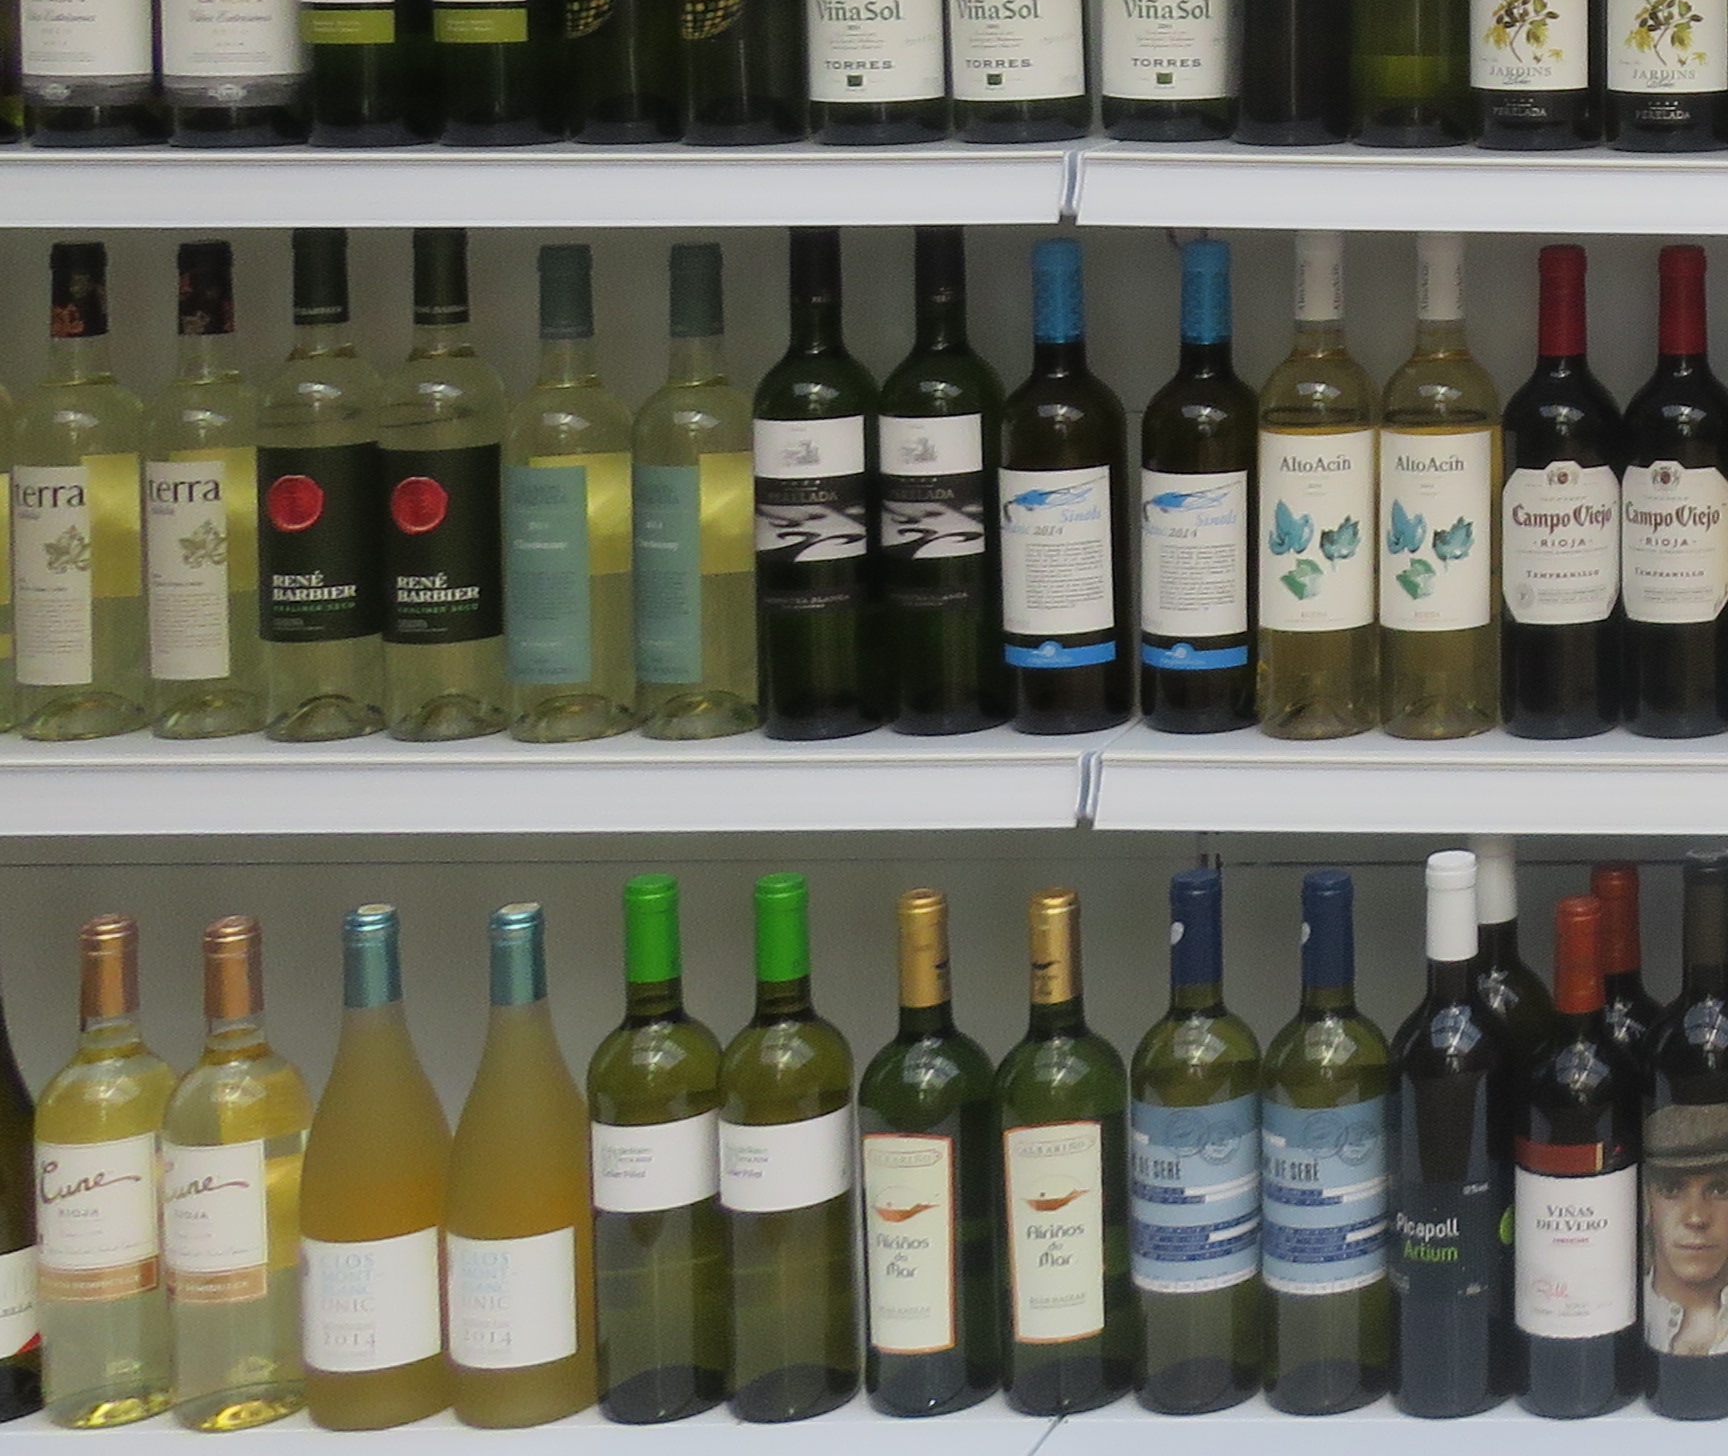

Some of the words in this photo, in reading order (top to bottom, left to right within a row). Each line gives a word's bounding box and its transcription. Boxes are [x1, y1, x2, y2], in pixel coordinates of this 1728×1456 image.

[1632, 68, 1697, 82] JARDINS
[1512, 504, 1571, 535] Campo
[1573, 503, 1613, 528] Viejo
[1625, 505, 1673, 535] Campo
[1675, 503, 1720, 529] Viejo
[1033, 524, 1064, 537] 2014
[272, 570, 324, 586] RENÉ
[396, 572, 445, 589] RENÉ
[1526, 568, 1600, 580] TEMPRANILLO
[272, 584, 357, 601] BARBIER
[395, 586, 481, 603] BARBIER
[1545, 1203, 1595, 1218] VIÑAS
[1396, 1212, 1462, 1238] Picapoll
[1535, 1217, 1560, 1232] DEL
[1562, 1216, 1609, 1232] VERO
[1403, 1241, 1459, 1261] Artium
